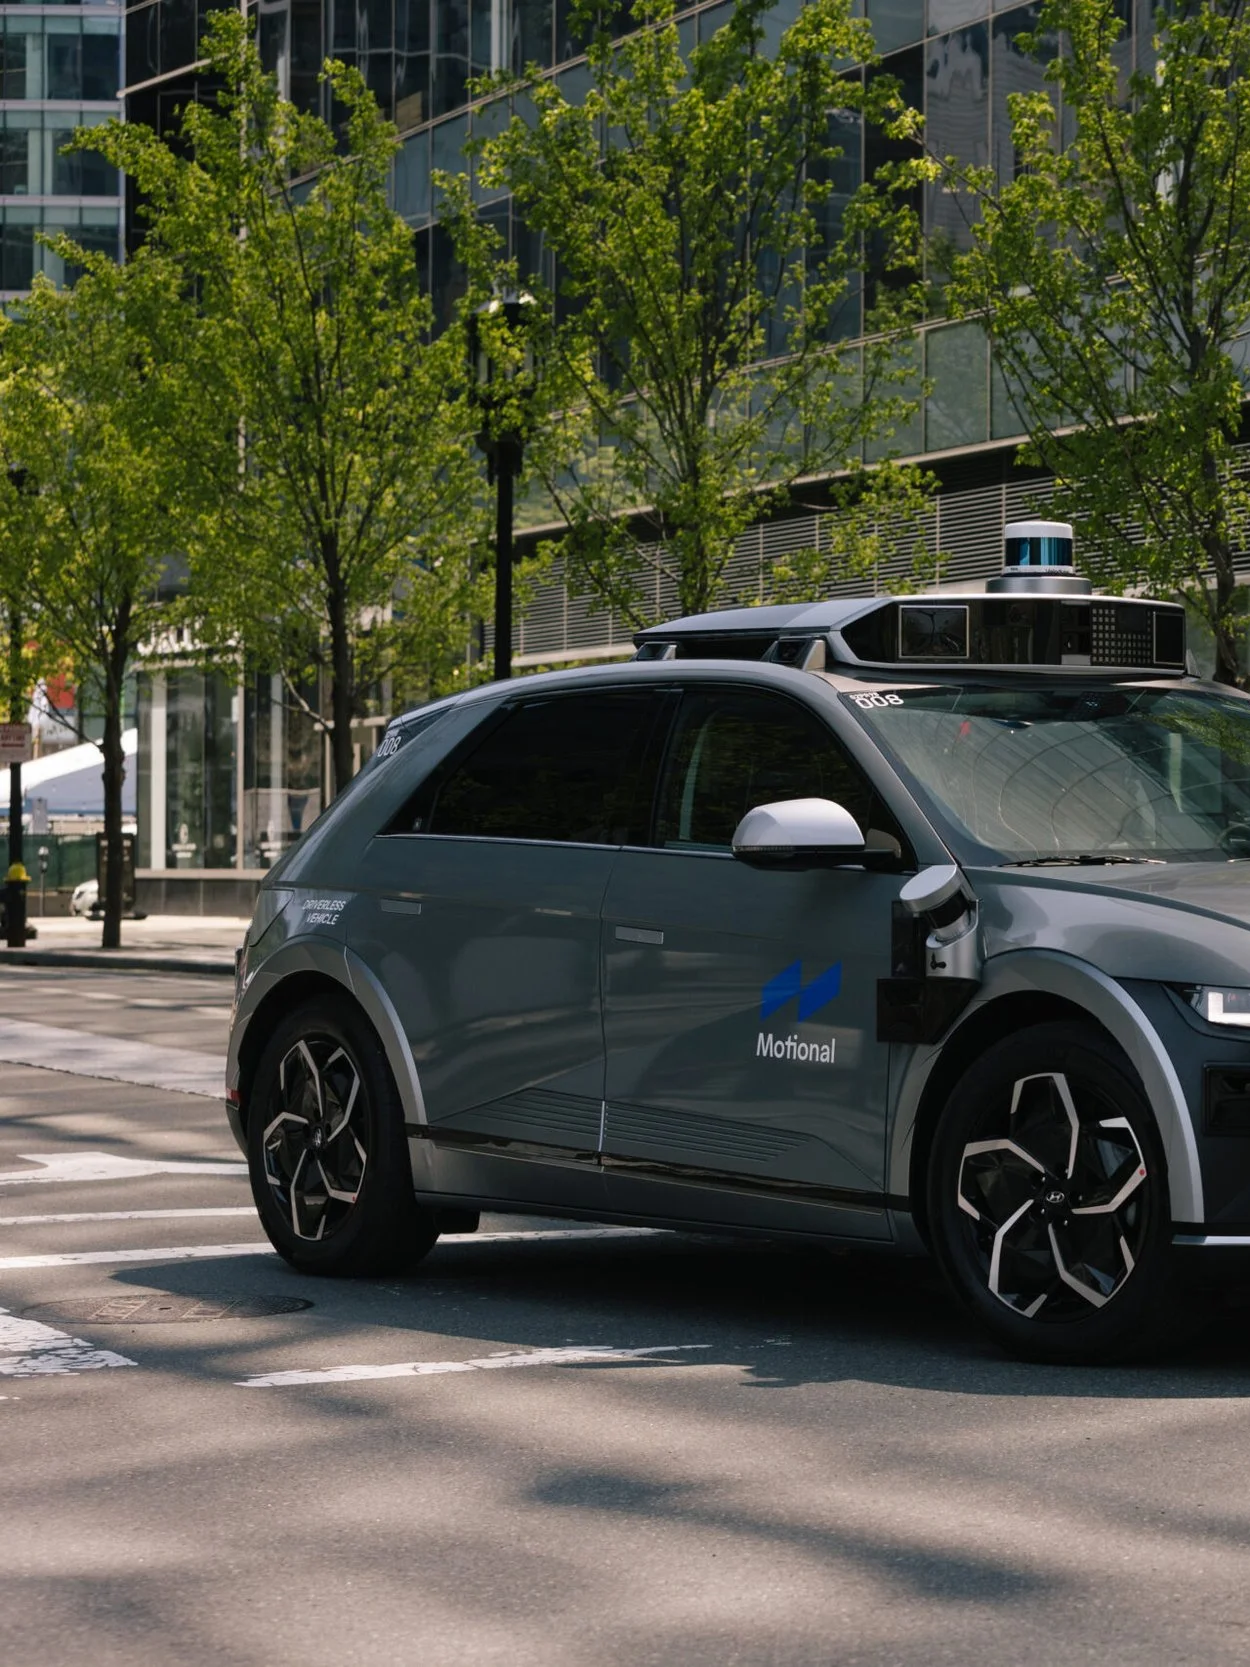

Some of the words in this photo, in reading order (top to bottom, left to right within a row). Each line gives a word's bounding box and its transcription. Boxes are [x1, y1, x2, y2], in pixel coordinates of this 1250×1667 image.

[855, 694, 904, 709] 008
[377, 736, 402, 757] 008
[302, 899, 346, 911] DRIVERLESS
[306, 913, 340, 925] VEHICLE
[756, 1032, 836, 1064] Motional
